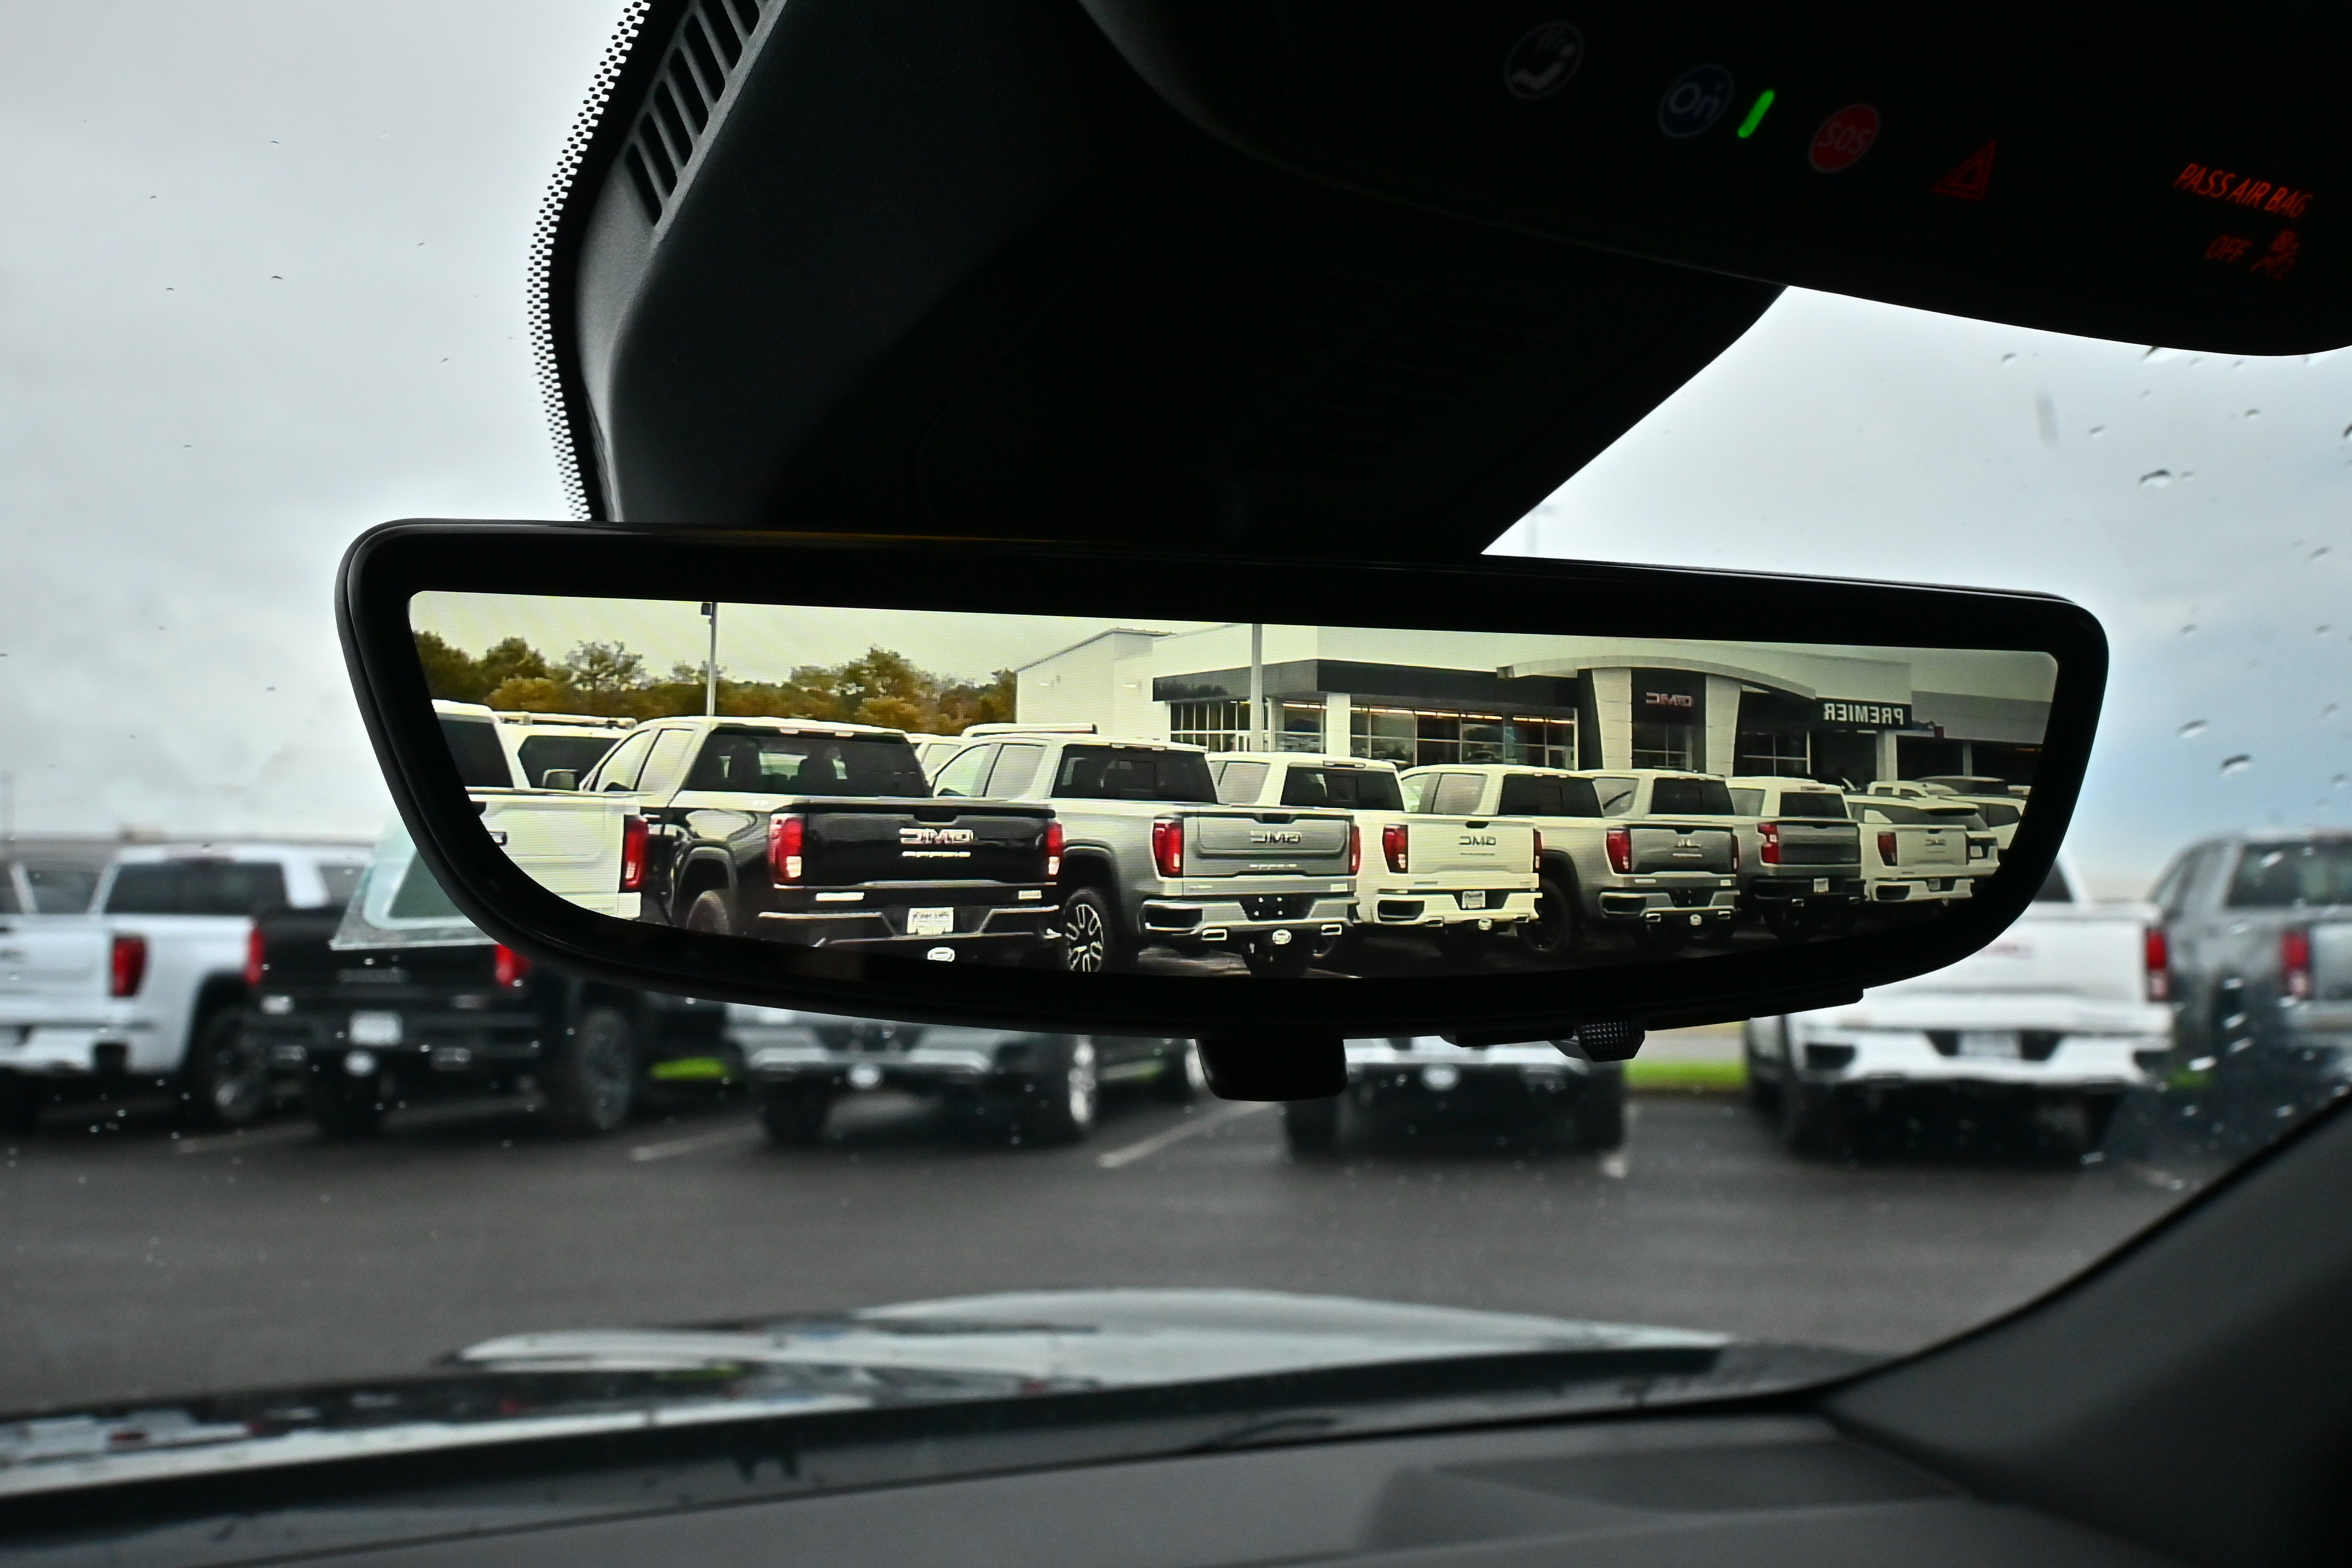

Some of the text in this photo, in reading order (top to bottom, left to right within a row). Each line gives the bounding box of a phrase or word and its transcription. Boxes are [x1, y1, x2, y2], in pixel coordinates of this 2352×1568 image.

[1669, 83, 1723, 120] On
[1816, 121, 1875, 153] SOS
[2172, 163, 2314, 218] PASS AIR BAG
[2205, 235, 2251, 264] OFF
